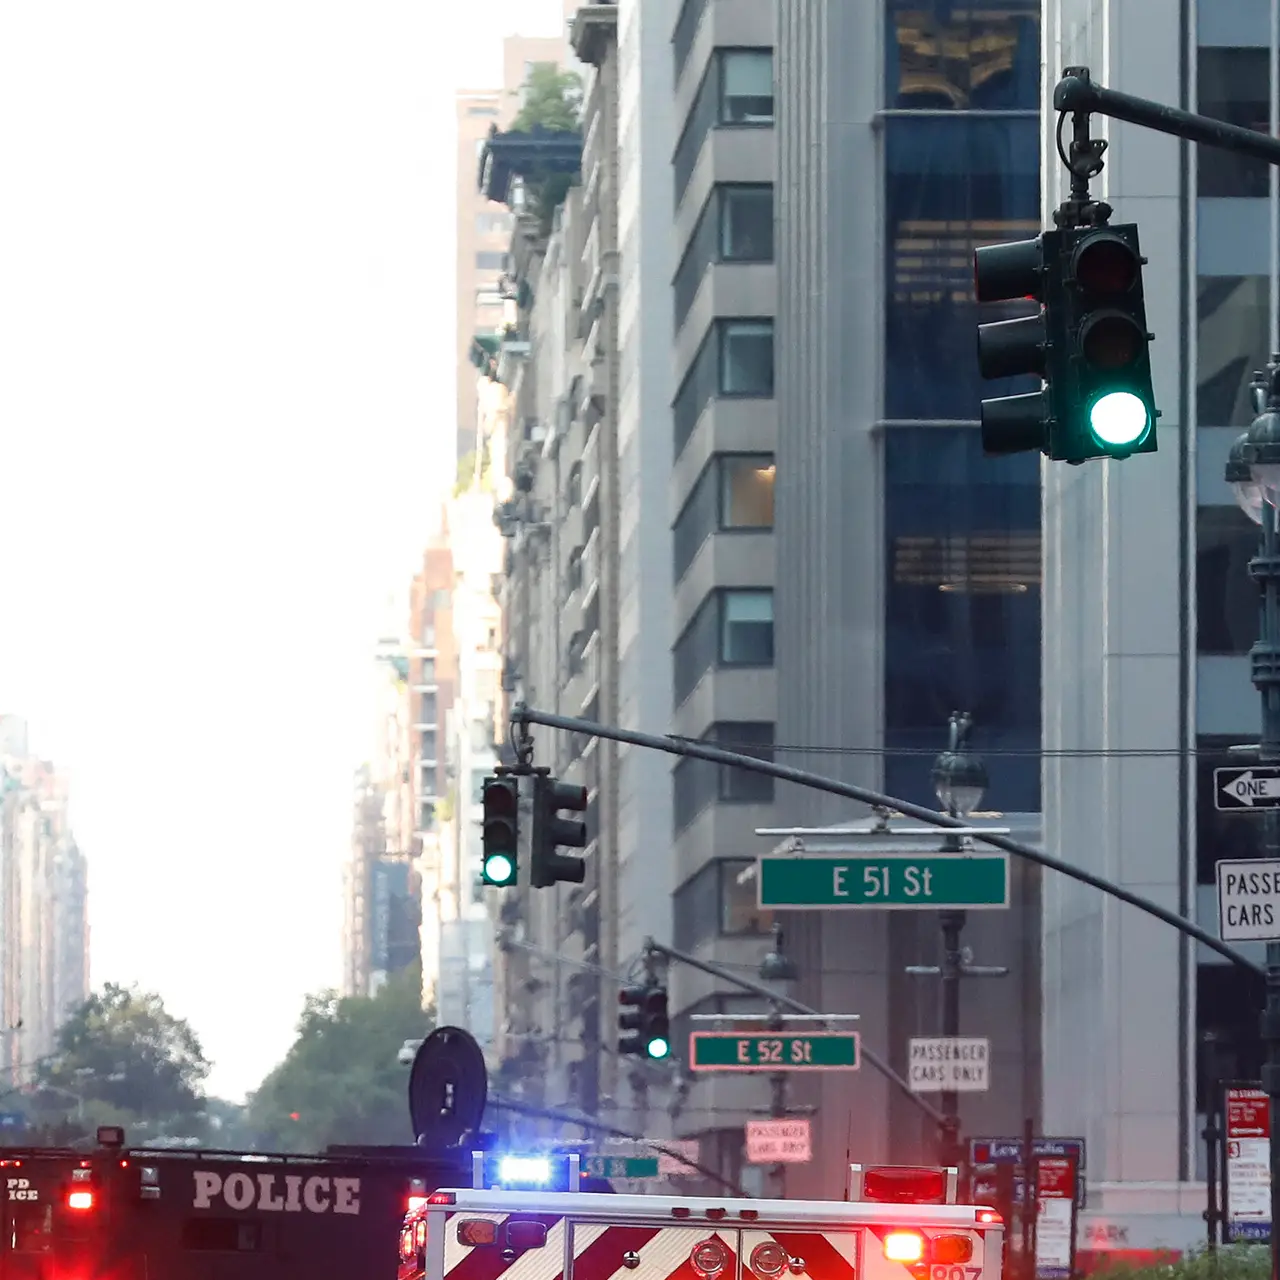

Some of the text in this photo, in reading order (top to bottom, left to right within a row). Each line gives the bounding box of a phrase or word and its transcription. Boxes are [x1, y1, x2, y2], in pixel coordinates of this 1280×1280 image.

[1236, 780, 1268, 796] ONE
[833, 866, 933, 897] E 51 St
[1227, 903, 1274, 926] CARS
[738, 1039, 811, 1063] E 52 St
[912, 1045, 986, 1061] PASSENGER
[912, 1066, 983, 1082] CARS ONLY
[7, 1178, 30, 1189] PD
[9, 1190, 38, 1200] ICE
[192, 1170, 361, 1215] POLICE
[1085, 1225, 1129, 1241] PARK
